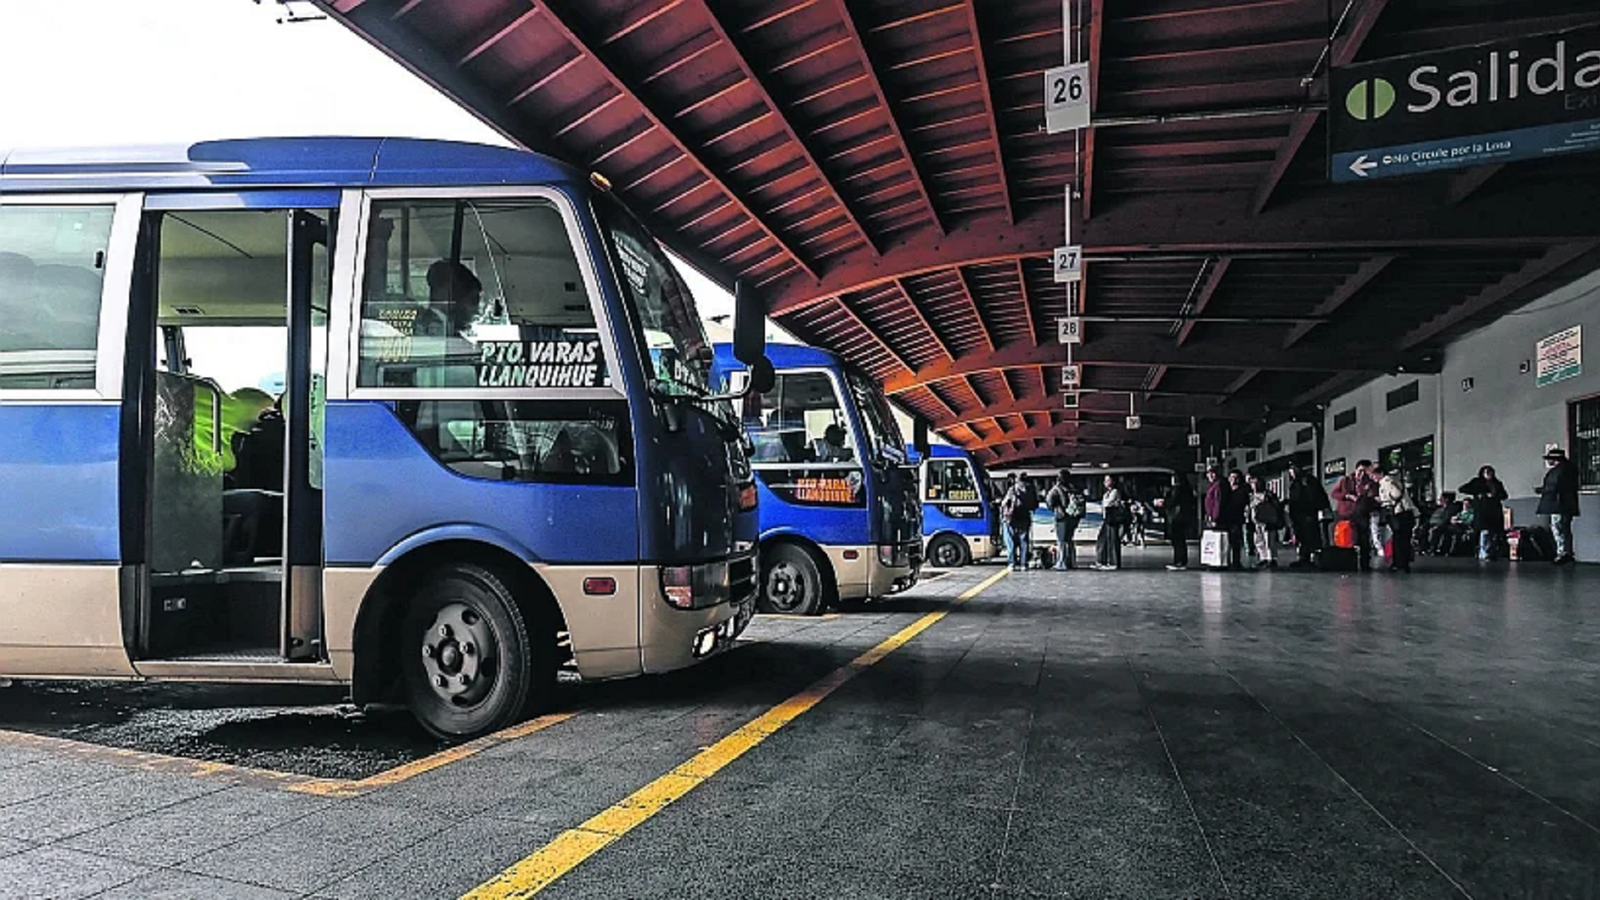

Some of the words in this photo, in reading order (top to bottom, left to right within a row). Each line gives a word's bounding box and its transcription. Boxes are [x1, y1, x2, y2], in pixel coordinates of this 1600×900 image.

[1407, 40, 1600, 112] Salida
[1053, 75, 1082, 104] 26
[1059, 252, 1077, 269] 27
[481, 341, 525, 363] PTO.
[530, 340, 599, 364] VARAS
[478, 364, 598, 388] LLANQUIHUE
